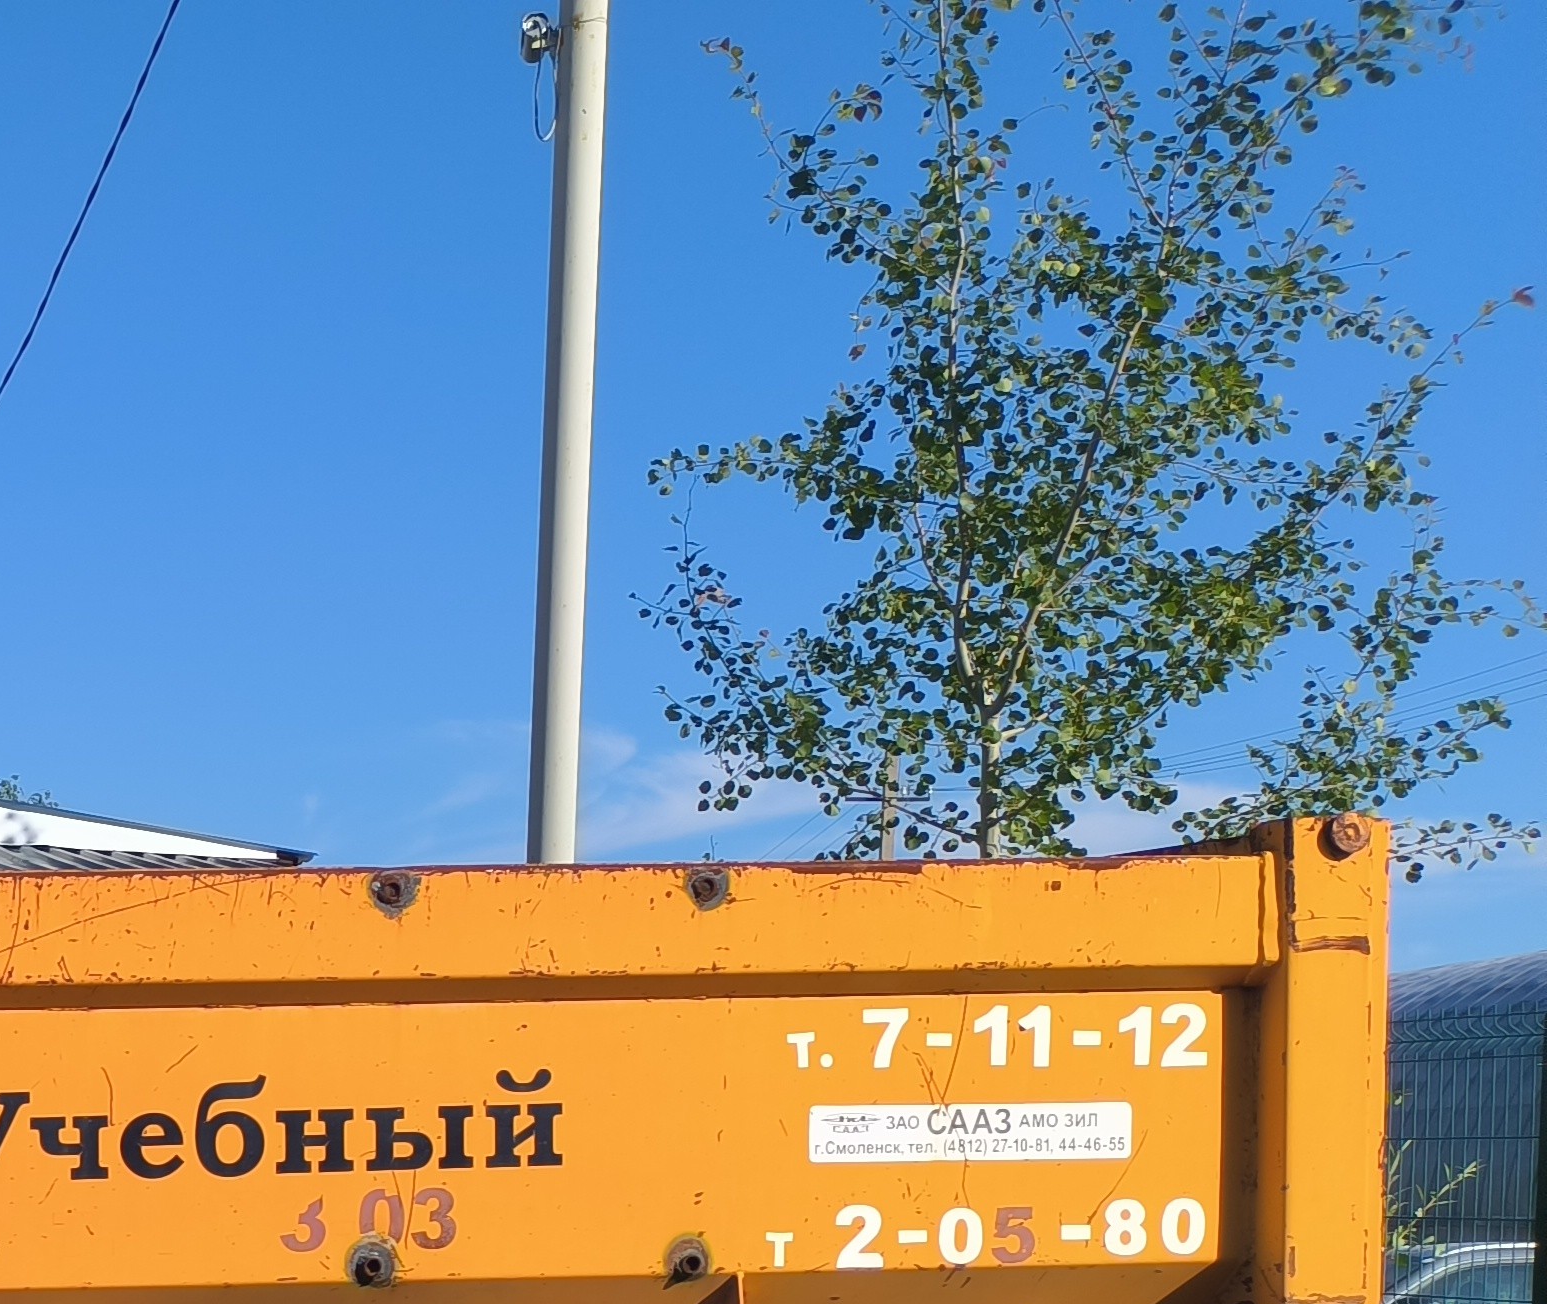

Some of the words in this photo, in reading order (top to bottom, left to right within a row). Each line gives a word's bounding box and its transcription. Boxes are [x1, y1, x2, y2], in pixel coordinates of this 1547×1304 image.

[786, 1031, 834, 1069] т.
[862, 1003, 1208, 1069] 7-11-12
[886, 1114, 920, 1130] ЗАО
[926, 1108, 1012, 1136] СААЗ
[1019, 1112, 1059, 1129] АМО
[1064, 1113, 1098, 1128] ЗИЛ
[908, 1141, 938, 1154] тел.
[943, 1138, 988, 1157] (4812)
[992, 1138, 1054, 1155] 27-10-81,
[1058, 1136, 1126, 1152] 44-46-55
